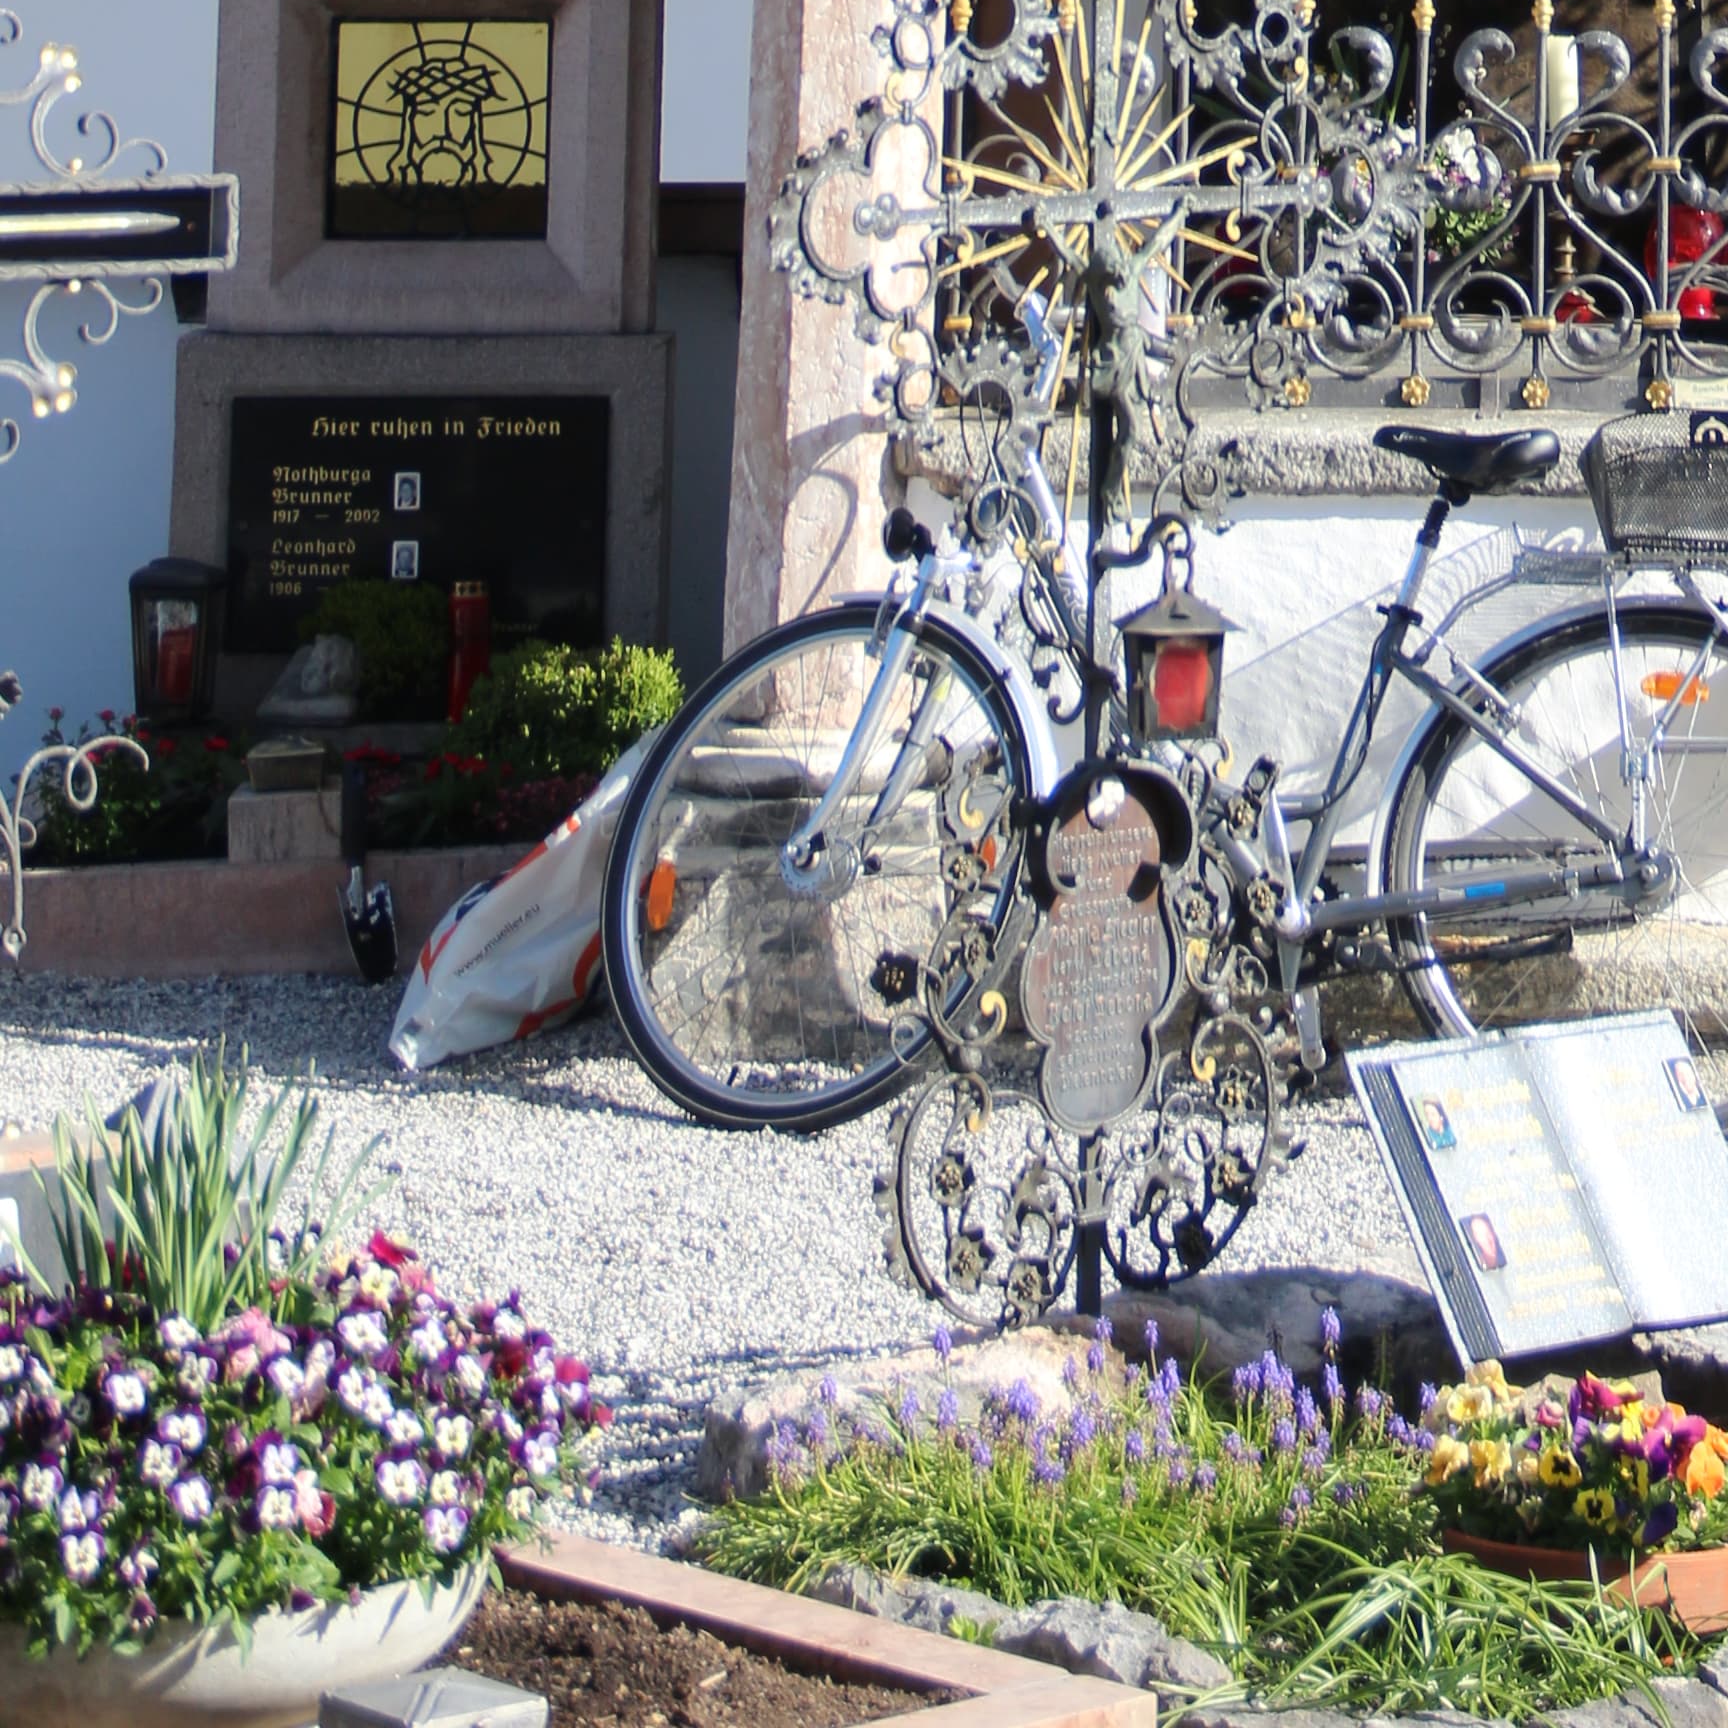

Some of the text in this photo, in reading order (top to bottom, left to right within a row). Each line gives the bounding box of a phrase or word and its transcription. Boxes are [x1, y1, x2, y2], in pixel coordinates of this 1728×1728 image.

[311, 416, 561, 439] Hier ruhen in Frieden
[272, 465, 371, 486] Nothburga
[271, 487, 352, 505] Brunner
[272, 509, 300, 524] 1917
[344, 509, 380, 523] 2002
[271, 538, 356, 556] Leonhard
[270, 560, 350, 577] Brunner
[270, 581, 302, 595] 1906
[453, 903, 540, 977] www.mueller.eu
